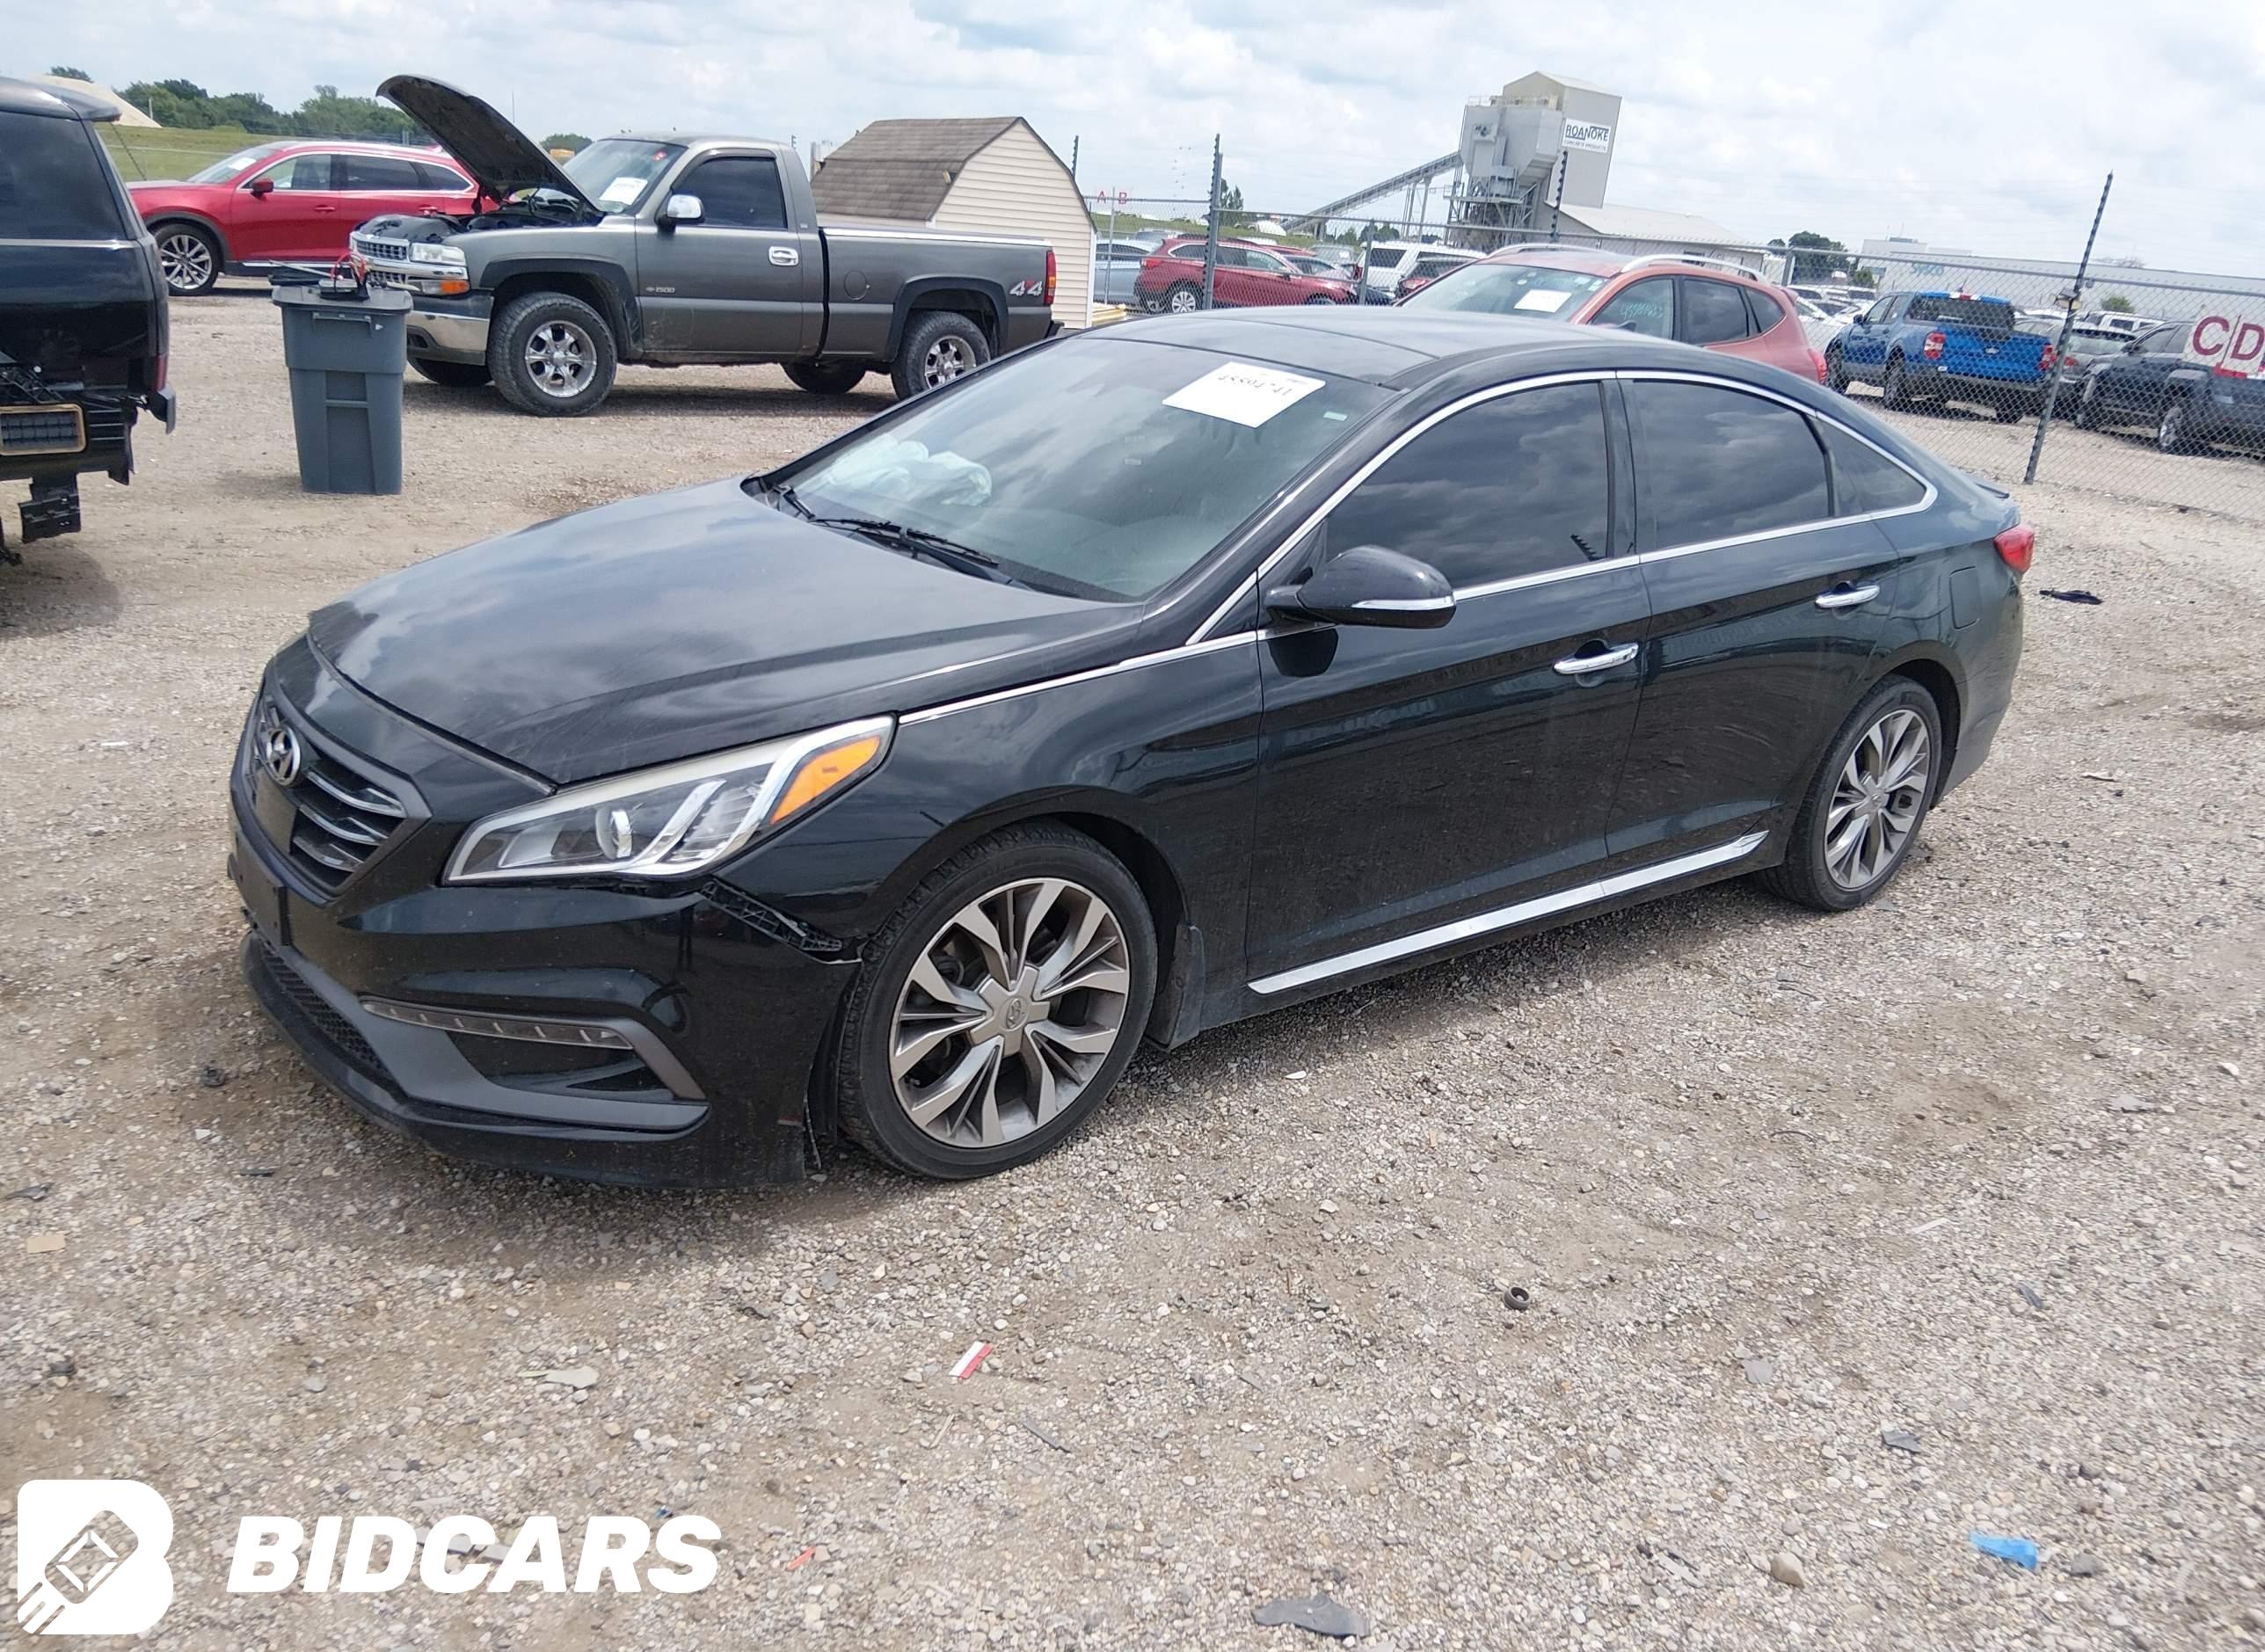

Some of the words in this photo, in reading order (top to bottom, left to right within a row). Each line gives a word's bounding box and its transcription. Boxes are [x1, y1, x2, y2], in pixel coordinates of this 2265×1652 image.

[1565, 124, 1609, 142] ROANOKE
[1097, 190, 1106, 203] A
[1118, 192, 1127, 204] B
[2193, 317, 2230, 356] C
[2231, 323, 2264, 360] D
